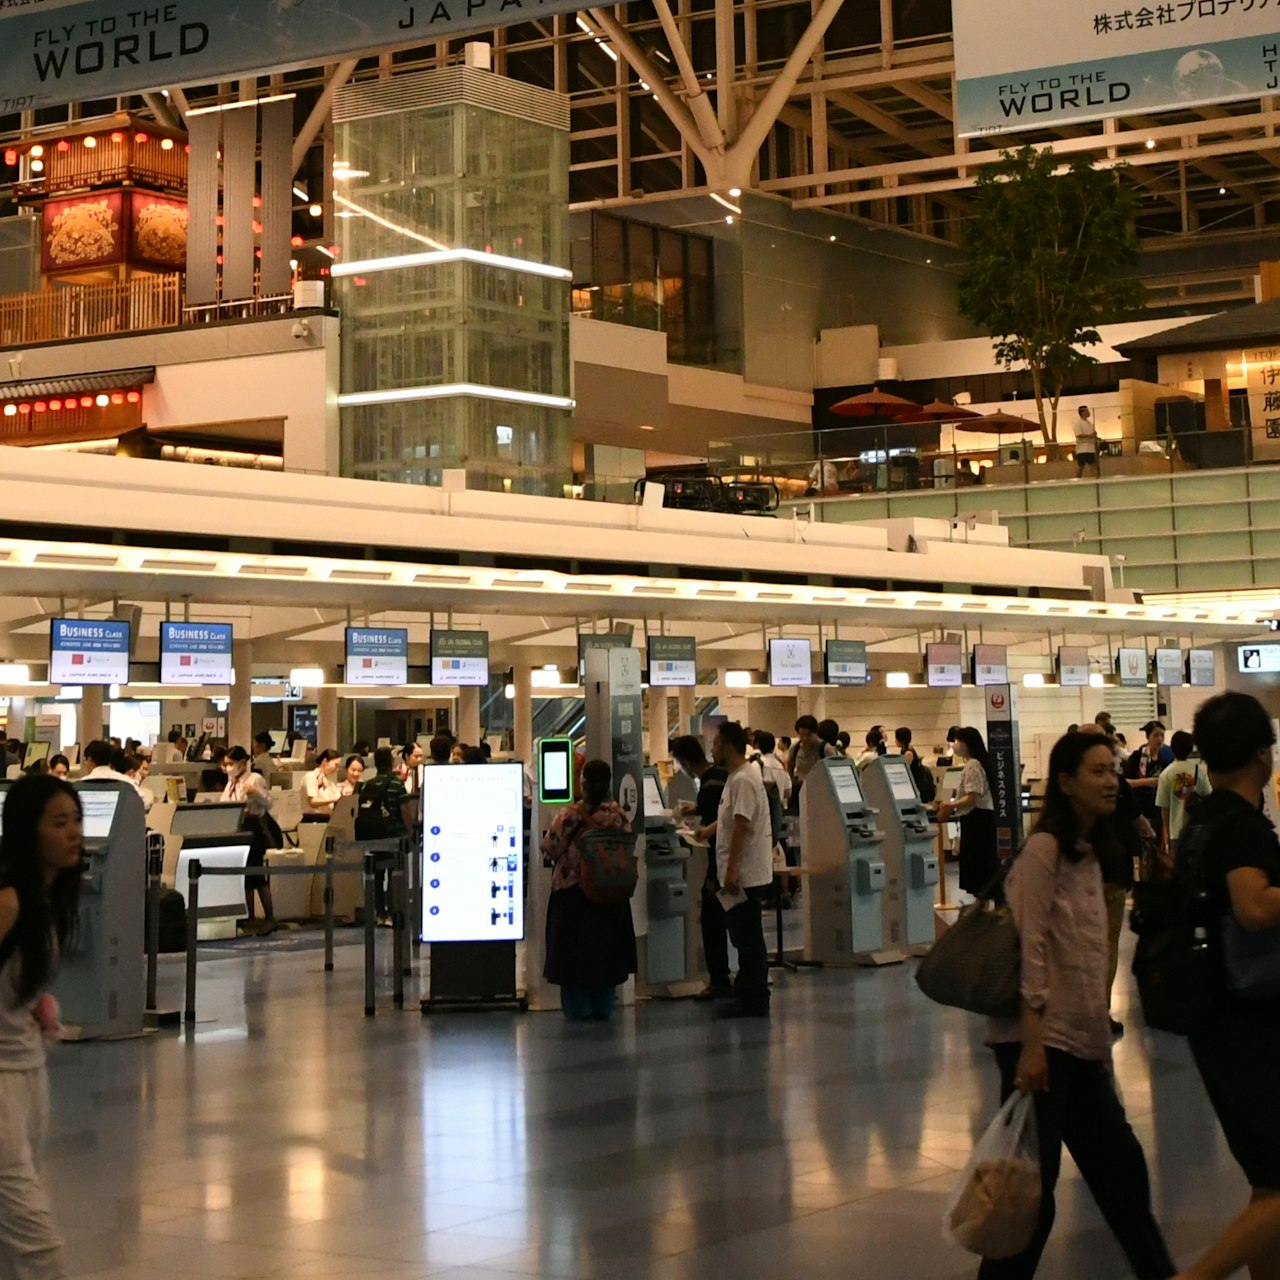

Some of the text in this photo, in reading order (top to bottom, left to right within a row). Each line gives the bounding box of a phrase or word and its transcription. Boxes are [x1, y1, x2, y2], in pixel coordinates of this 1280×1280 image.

[34, 4, 178, 48] FLY TO THE
[33, 22, 210, 82] WORLD
[998, 70, 1107, 97] FLY TO THE
[999, 81, 1131, 118] WORLD
[60, 624, 104, 638] BUSINESS
[168, 627, 209, 640] BUSINESS
[352, 632, 388, 644] BUSINESS
[996, 751, 1007, 818] ビジネスクラス
